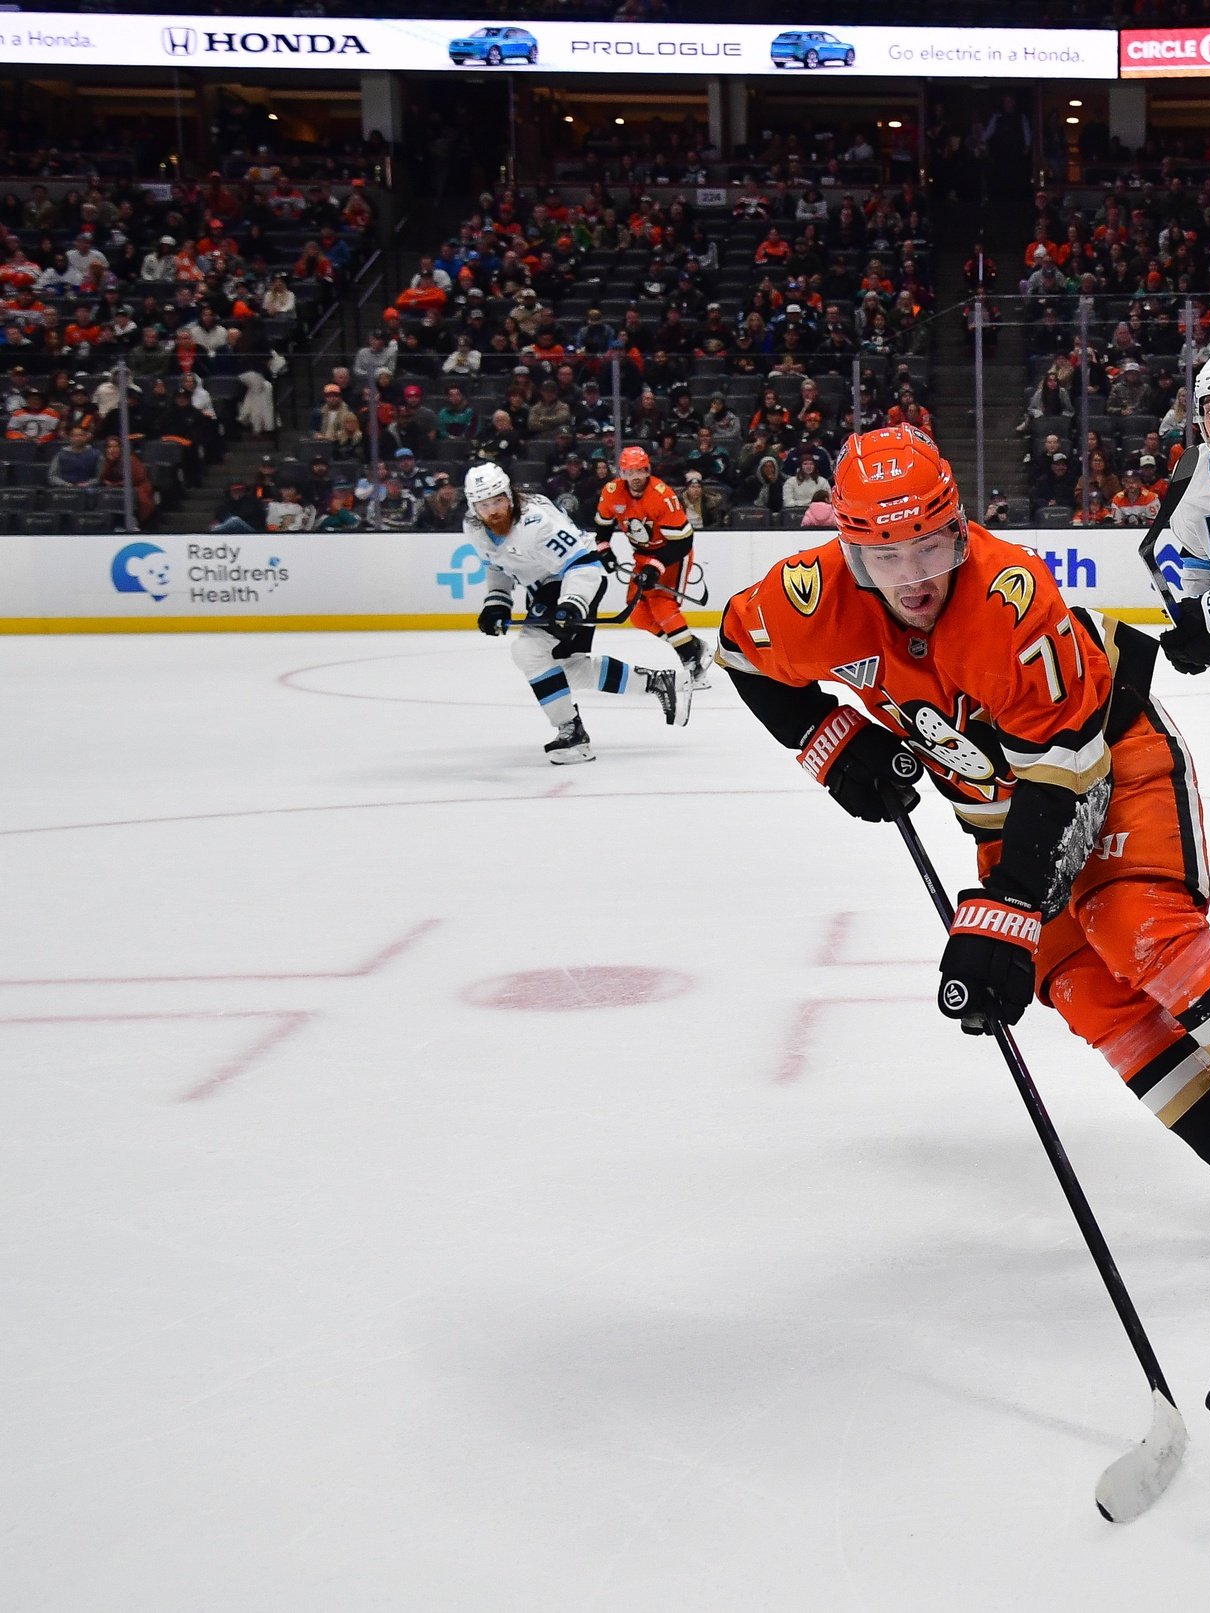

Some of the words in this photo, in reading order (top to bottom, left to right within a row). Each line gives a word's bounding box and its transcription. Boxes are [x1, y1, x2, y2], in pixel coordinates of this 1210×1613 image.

[12, 35, 21, 46] a
[28, 31, 96, 48] Honda.
[204, 32, 370, 55] HONDA
[571, 41, 742, 56] PROLOGUE
[888, 44, 914, 60] Go
[920, 45, 981, 61] electric
[988, 46, 1001, 60] in
[1008, 51, 1017, 62] a
[1024, 47, 1085, 63] Honda.
[1127, 40, 1197, 59] CIRCLE
[876, 506, 920, 525] CCM
[545, 529, 578, 558] 38
[187, 544, 241, 564] Rady
[190, 587, 259, 602] Health
[1018, 614, 1084, 704] 77
